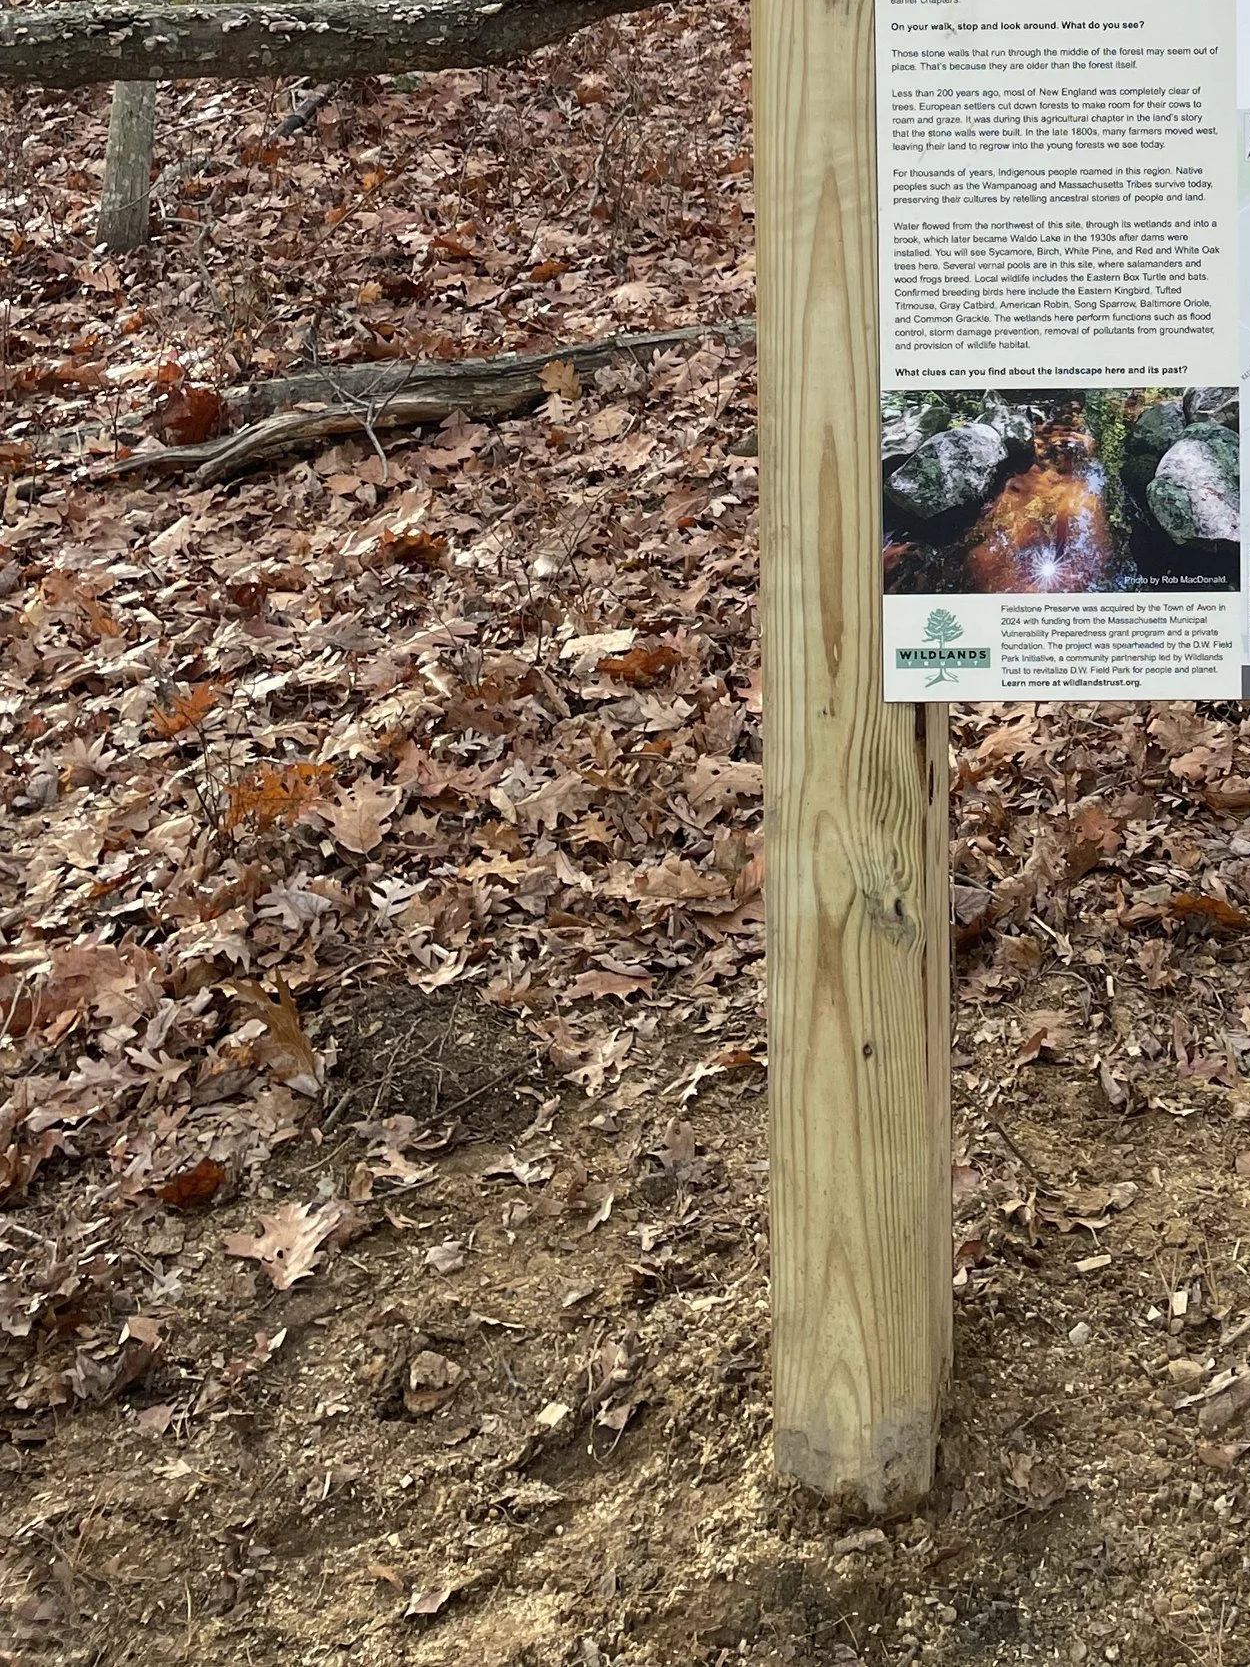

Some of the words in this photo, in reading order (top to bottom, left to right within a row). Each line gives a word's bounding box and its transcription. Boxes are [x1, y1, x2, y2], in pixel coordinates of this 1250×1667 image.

[891, 22, 904, 30] On
[907, 24, 928, 32] your
[931, 22, 955, 32] walk,
[957, 22, 978, 32] stop
[980, 22, 998, 30] and
[1001, 21, 1020, 29] look
[1023, 21, 1058, 29] around.
[1061, 21, 1085, 29] What
[1088, 20, 1100, 29] do
[1102, 22, 1119, 30] you
[1122, 20, 1144, 28] see?
[893, 168, 907, 177] For
[909, 168, 955, 177] thousands
[957, 168, 966, 176] of
[969, 169, 995, 178] years,
[998, 168, 1045, 178] Indigenous
[1048, 167, 1077, 177] people
[1079, 167, 1113, 175] roamed
[1115, 167, 1123, 175] in
[1125, 166, 1141, 175] this
[1143, 166, 1173, 176] region.
[1176, 166, 1203, 174] Native
[895, 368, 919, 376] What
[921, 368, 946, 376] clues
[968, 369, 985, 378] you
[988, 367, 1006, 375] find
[1009, 367, 1035, 375] about
[1037, 366, 1052, 375] the
[1055, 366, 1102, 375] landscape
[1105, 366, 1125, 374] here
[1128, 366, 1145, 374] and
[1148, 365, 1159, 374] its
[1162, 365, 1187, 375] past?
[1124, 575, 1148, 584] Photo
[1150, 576, 1160, 585] by
[1161, 575, 1178, 583] Rob
[900, 651, 986, 659] WILDLANDS
[1063, 679, 1141, 687] wildlandstrust.org.
